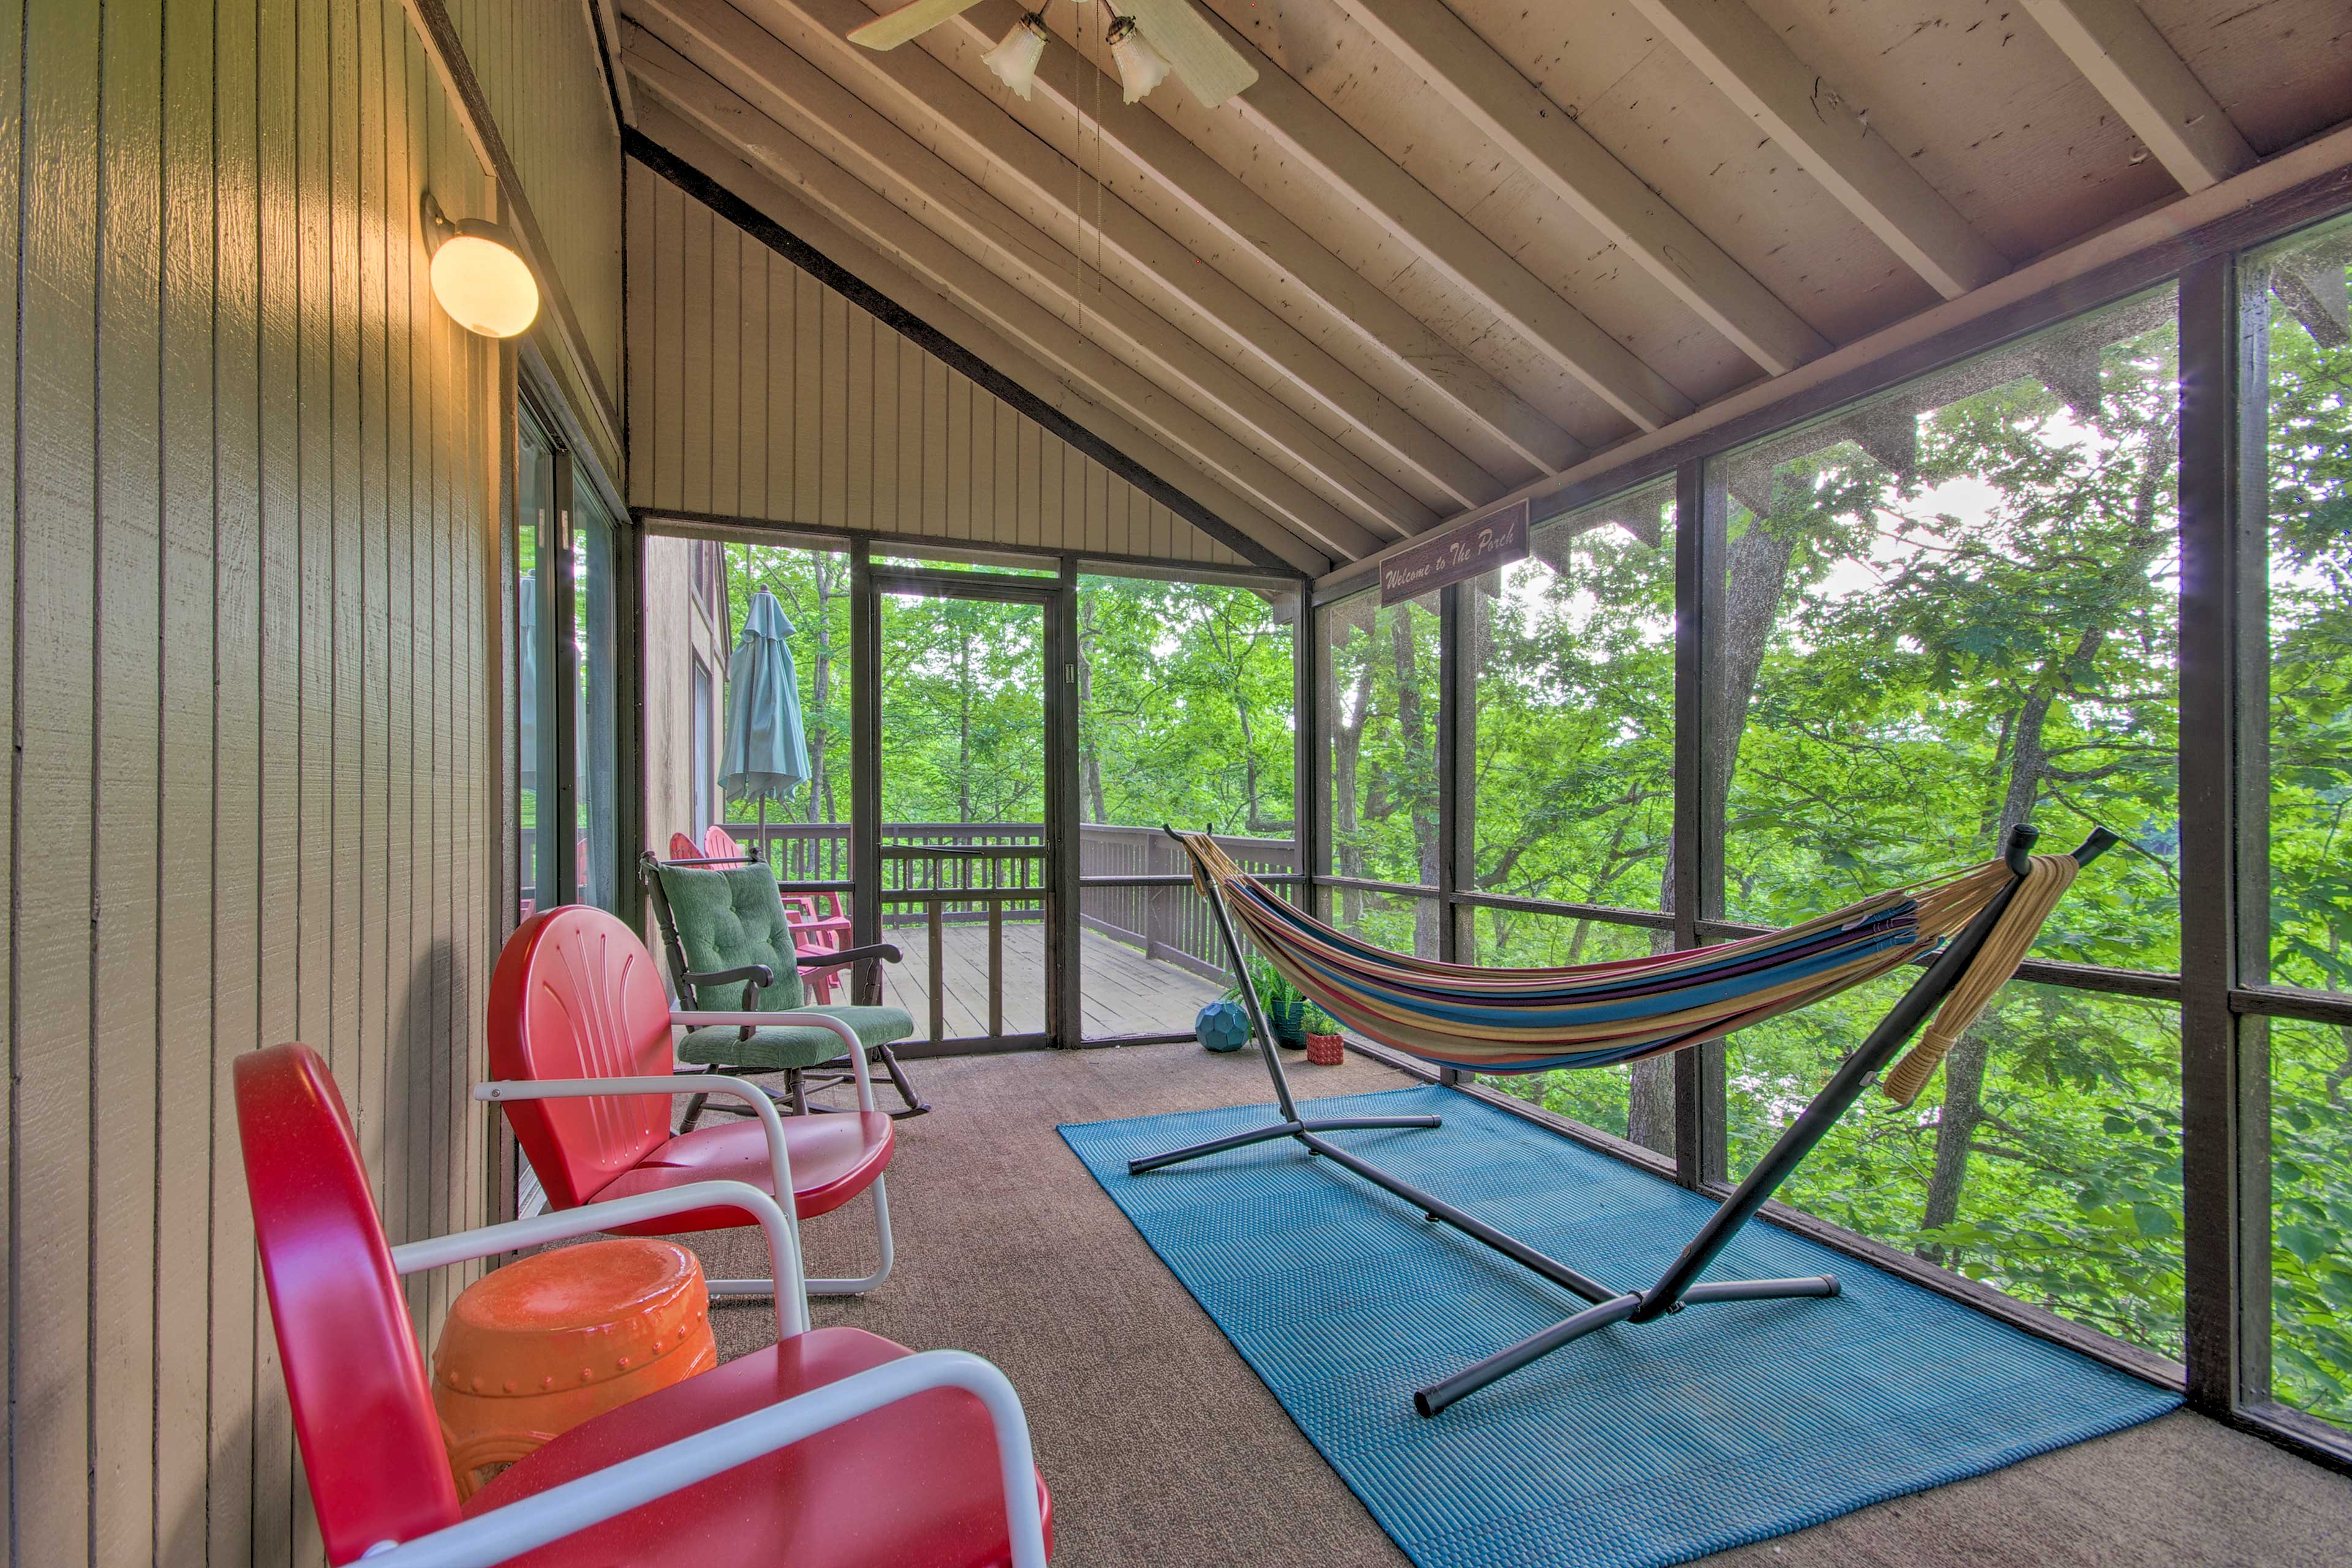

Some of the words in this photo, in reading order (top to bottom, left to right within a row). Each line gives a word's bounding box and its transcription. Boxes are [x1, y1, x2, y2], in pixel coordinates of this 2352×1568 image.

[1386, 564, 1430, 589] Welcome
[1436, 557, 1446, 570] to
[1450, 542, 1471, 566] The
[1478, 523, 1515, 555] Porch
